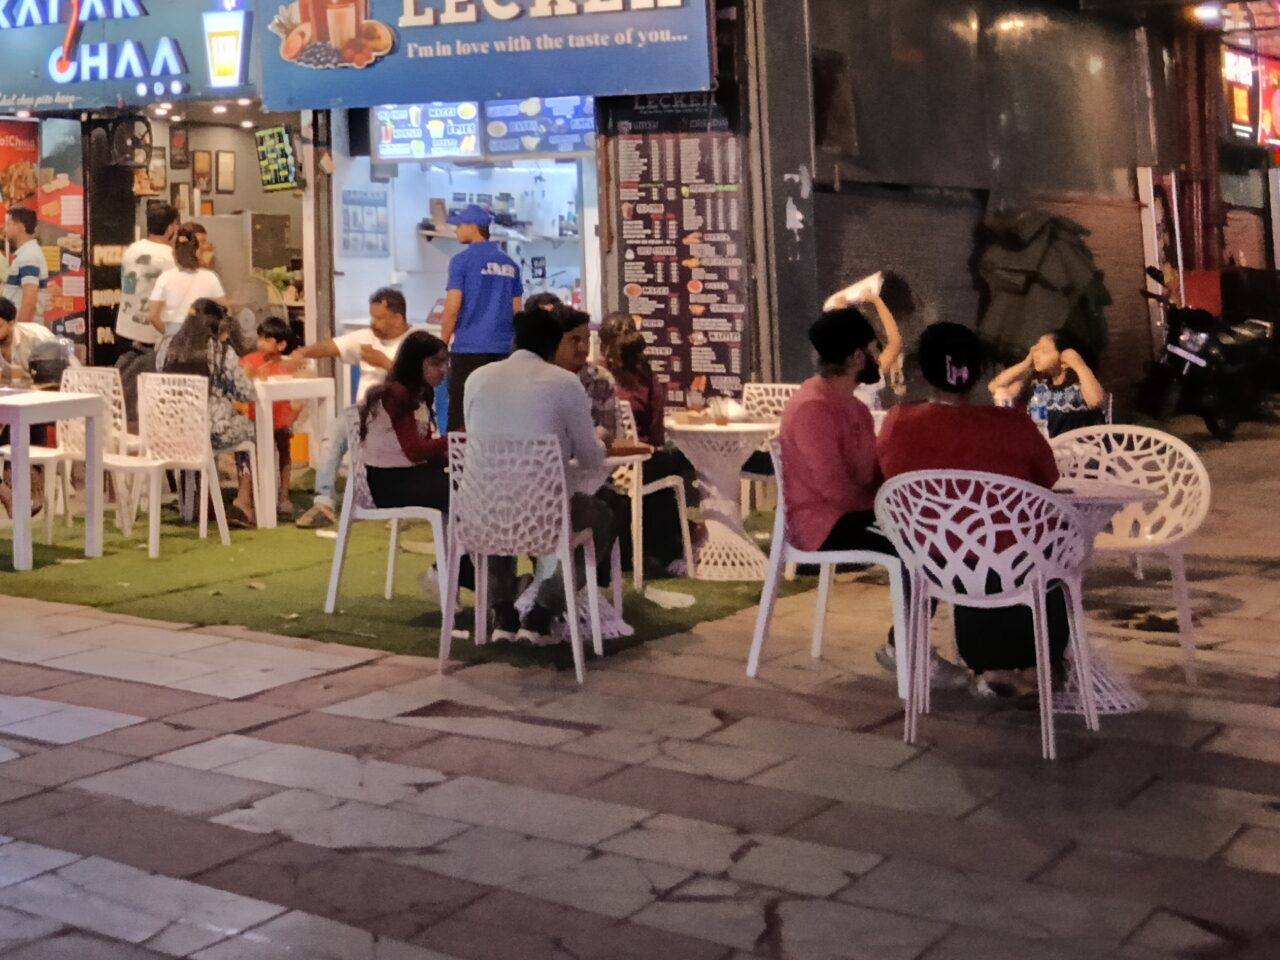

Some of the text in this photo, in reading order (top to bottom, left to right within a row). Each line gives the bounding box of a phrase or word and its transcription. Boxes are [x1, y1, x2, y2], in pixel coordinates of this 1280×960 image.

[48, 36, 183, 84] CHAA
[406, 42, 432, 59] I'm
[435, 41, 451, 57] in
[455, 38, 490, 56] love
[493, 35, 531, 53] with
[535, 32, 563, 50] the
[567, 31, 610, 49] taste
[614, 27, 634, 45] of
